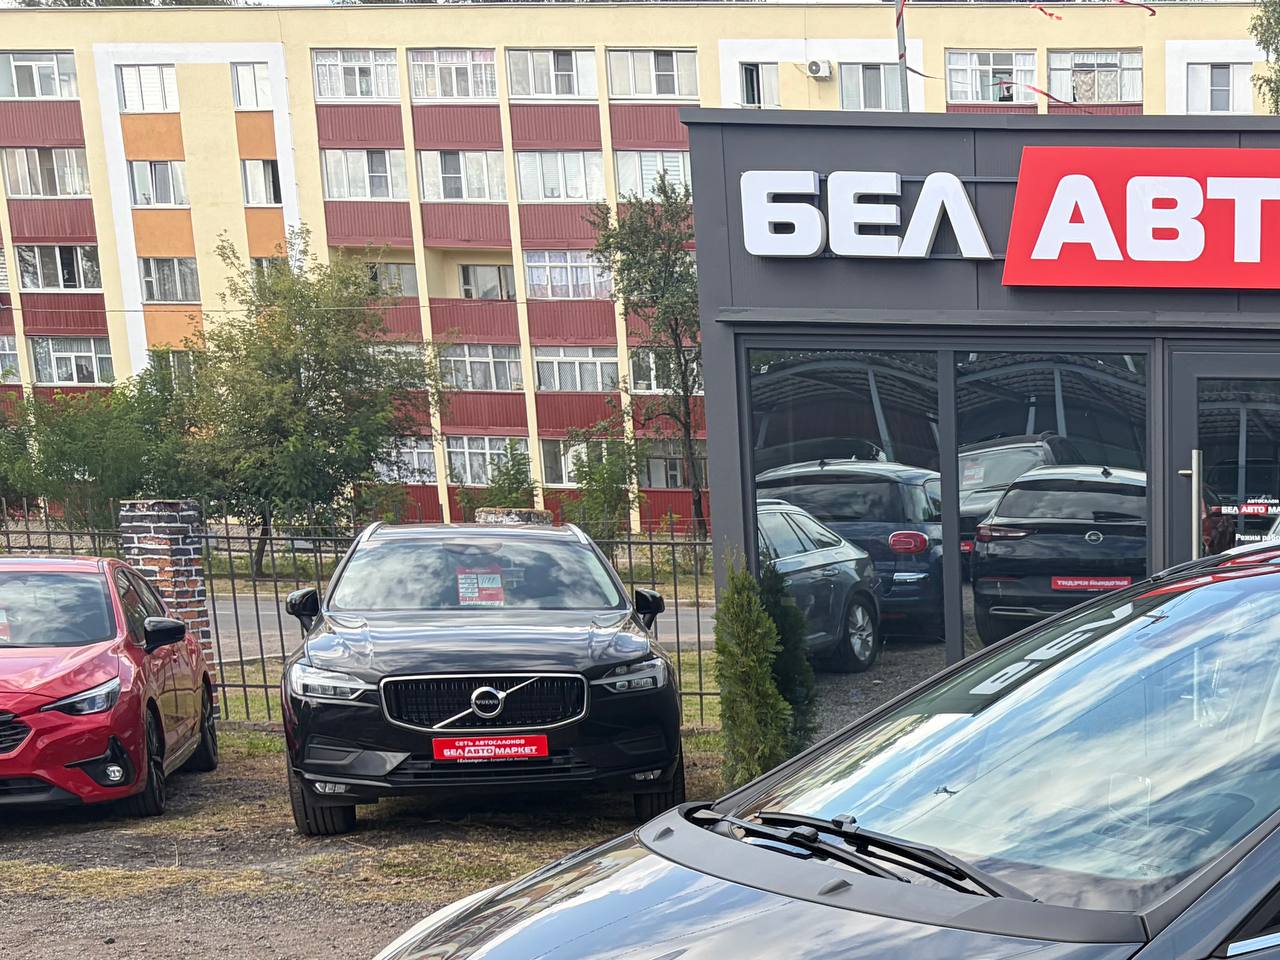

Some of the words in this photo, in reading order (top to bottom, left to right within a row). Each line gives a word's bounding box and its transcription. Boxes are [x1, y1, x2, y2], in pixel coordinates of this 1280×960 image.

[740, 170, 994, 258] БЕЛ
[1221, 505, 1239, 514] БЕЛ
[1241, 505, 1265, 514] АВТО
[1235, 533, 1261, 541] Режим
[475, 738, 526, 746] АВТОСАЛОНОВ
[443, 748, 464, 756] БЕЛ
[466, 747, 494, 756] АВТО
[495, 745, 538, 755] МАРКЕТ
